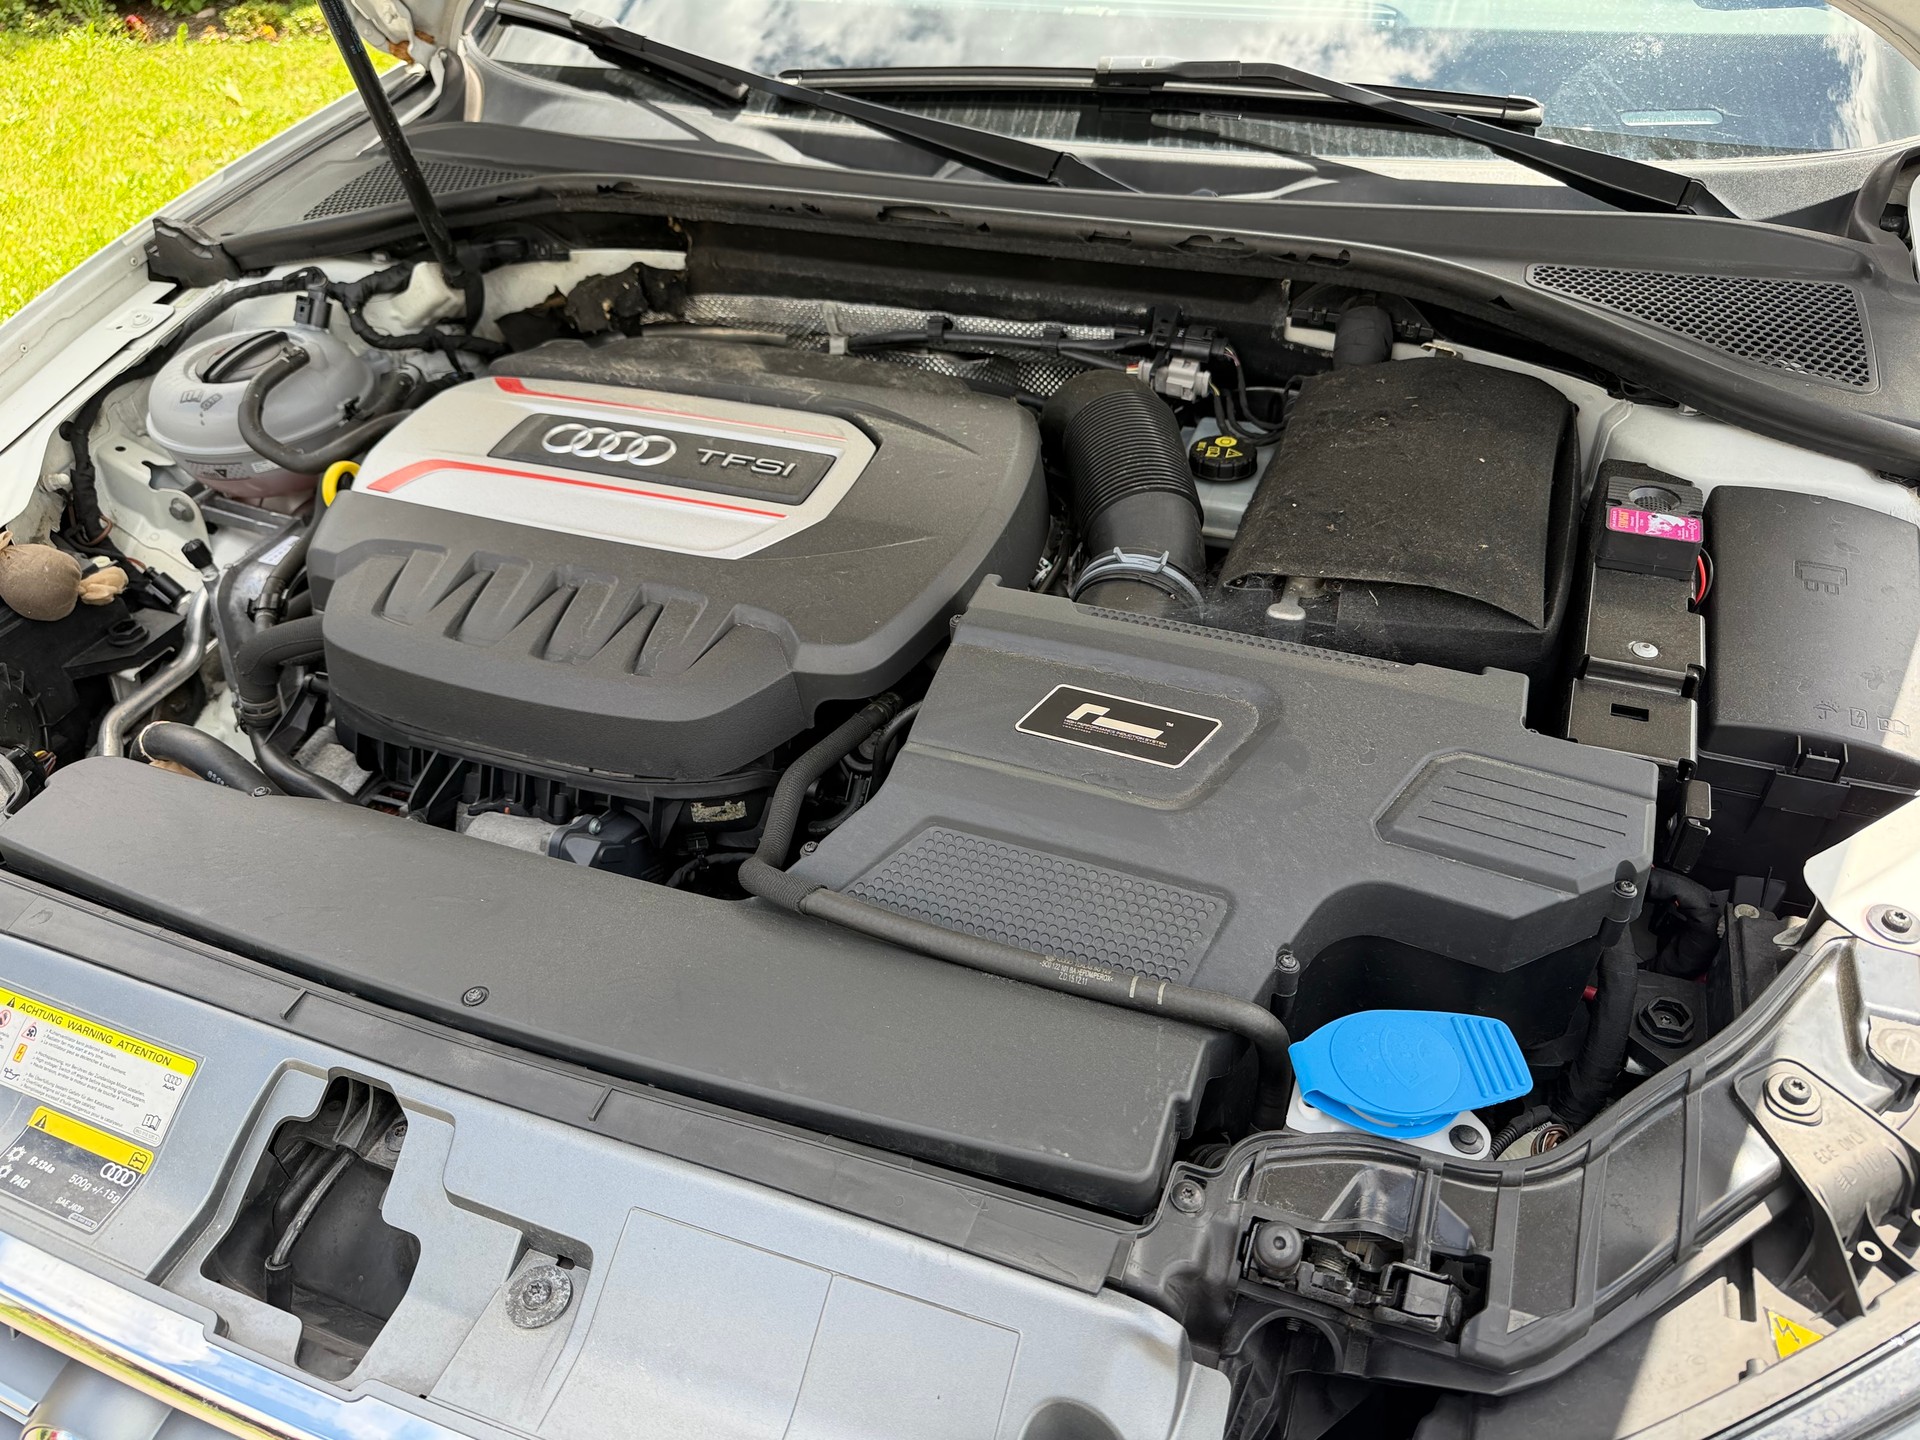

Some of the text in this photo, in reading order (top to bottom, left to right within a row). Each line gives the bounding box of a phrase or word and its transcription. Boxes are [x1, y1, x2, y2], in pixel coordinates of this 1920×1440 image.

[697, 448, 797, 477] TFSI
[19, 1003, 171, 1065] ACHTUNG WARNING ATTENTION
[10, 1175, 30, 1188] PAG
[28, 1156, 55, 1173] R-134a
[69, 1174, 92, 1191] 500g
[56, 1197, 84, 1213] SAE J639
